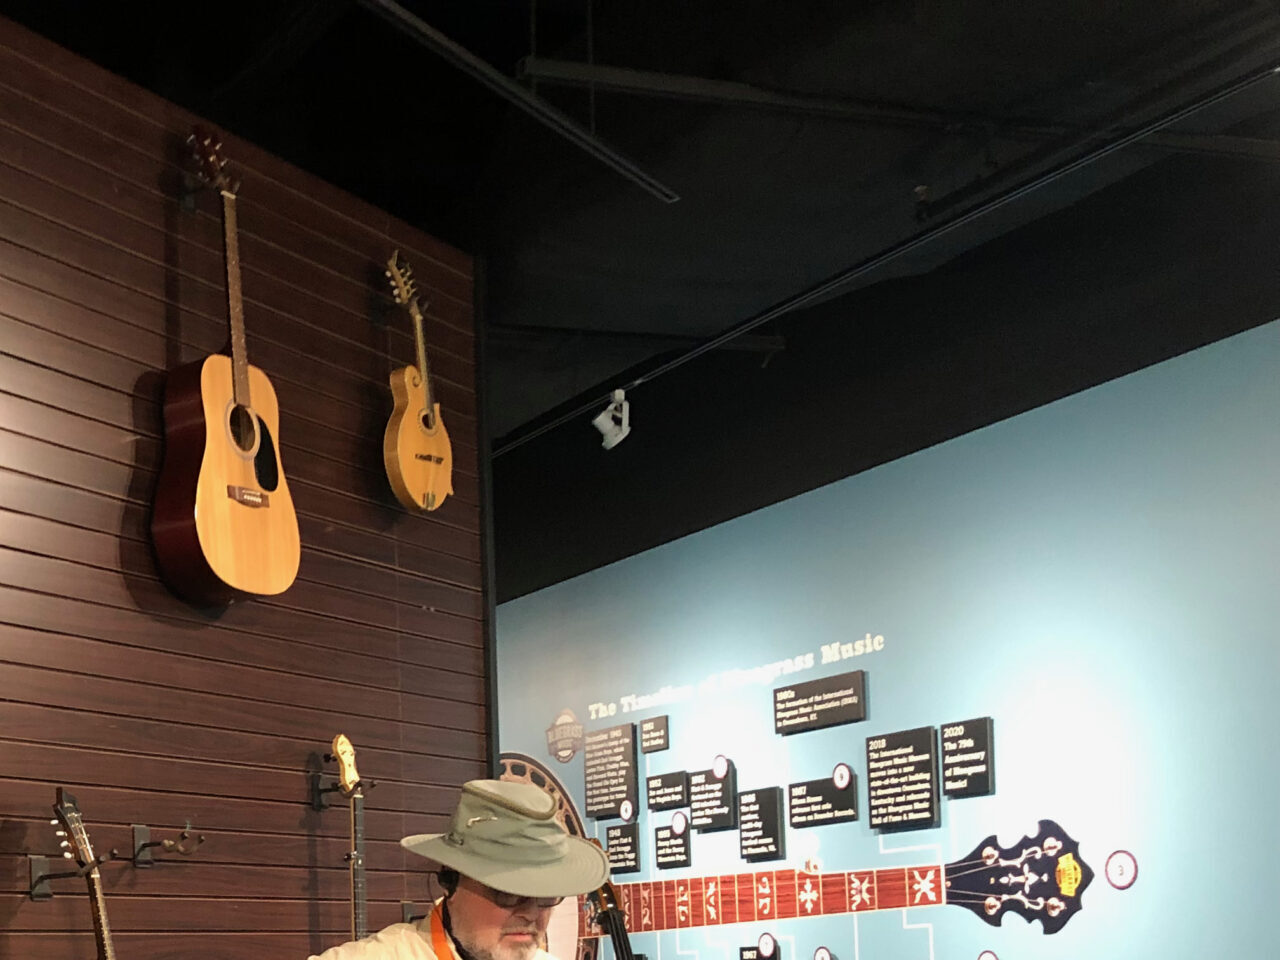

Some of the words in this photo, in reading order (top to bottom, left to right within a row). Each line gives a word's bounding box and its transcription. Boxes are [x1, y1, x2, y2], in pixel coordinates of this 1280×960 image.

[588, 702, 617, 720] The
[820, 633, 885, 665] Music
[944, 725, 964, 738] 2020
